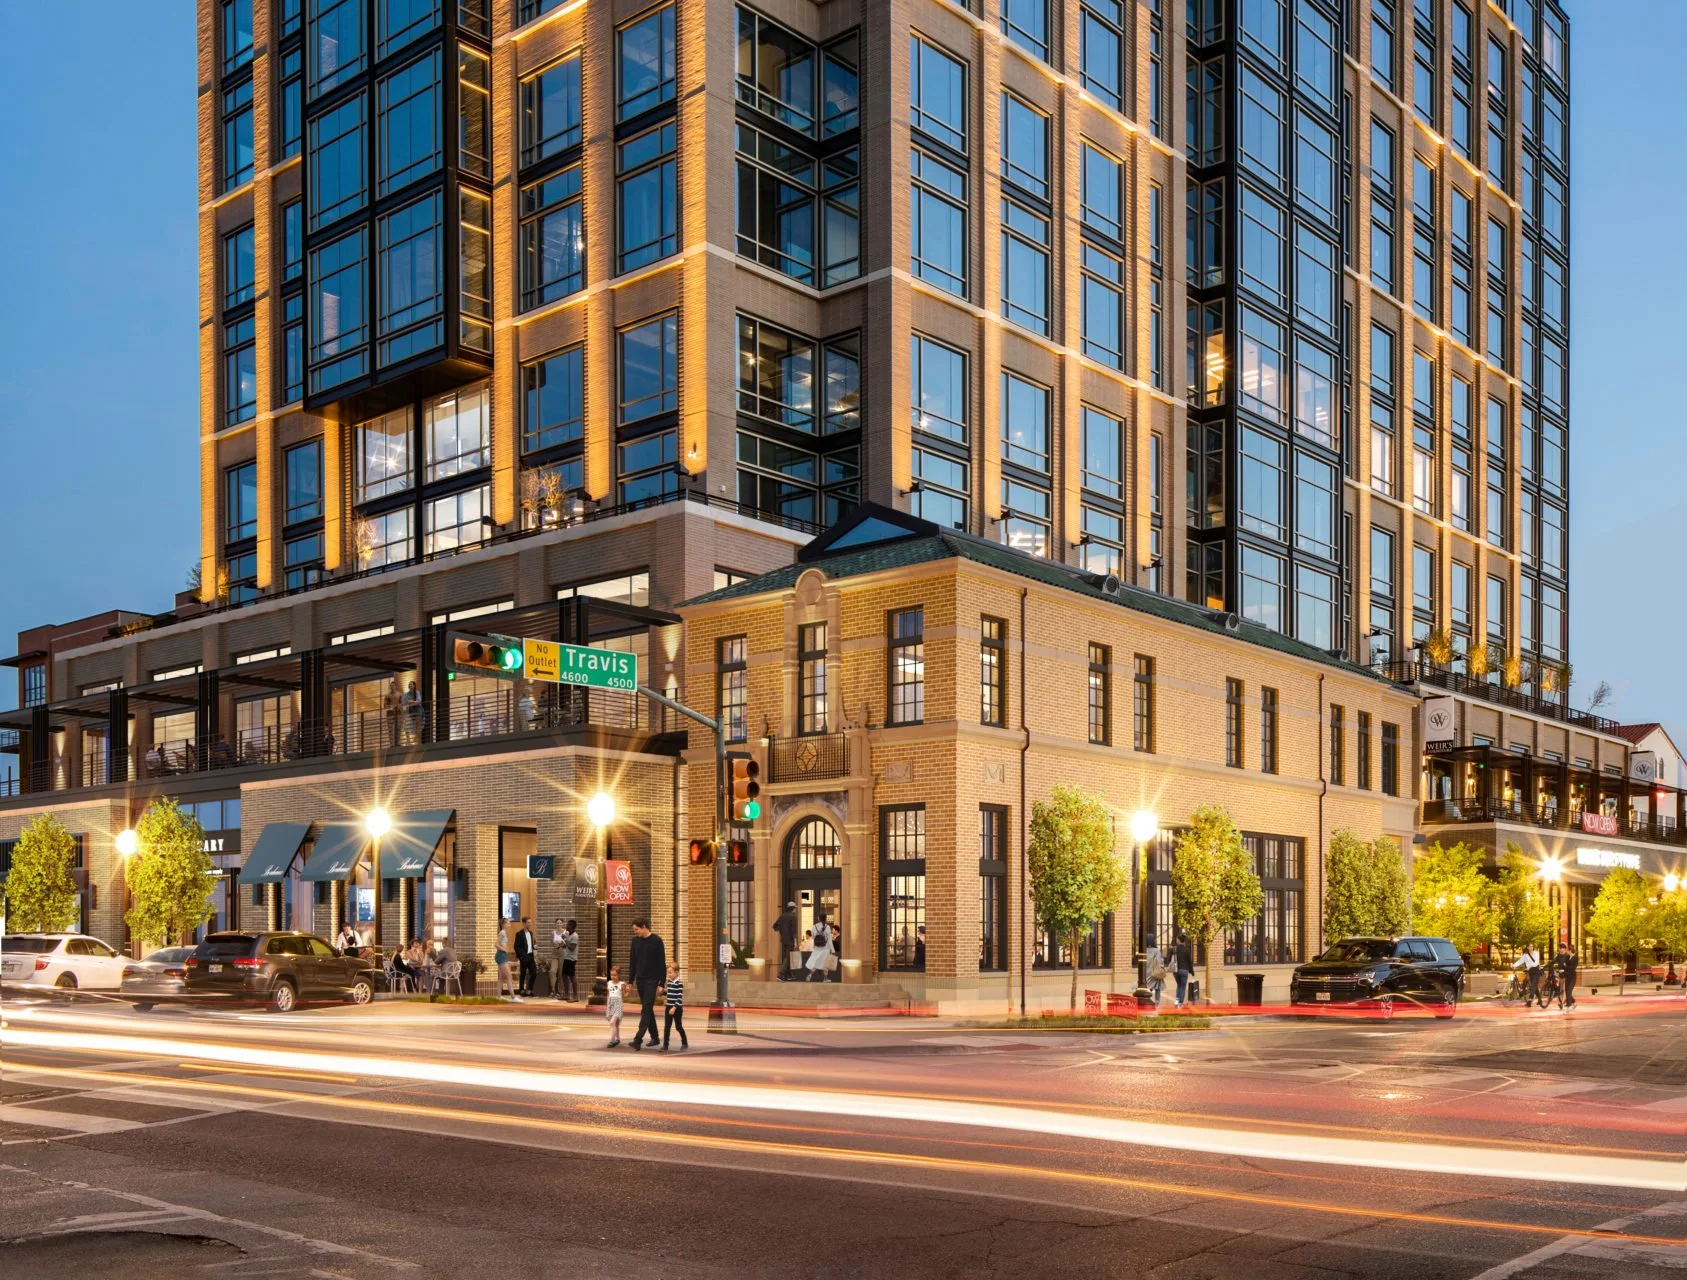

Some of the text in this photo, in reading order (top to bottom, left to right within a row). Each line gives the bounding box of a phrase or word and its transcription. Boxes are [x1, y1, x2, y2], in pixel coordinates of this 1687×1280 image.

[536, 644, 548, 654] No
[528, 655, 557, 668] Outlet
[565, 648, 629, 674] Travis
[561, 672, 633, 688] 4600 4500
[1427, 741, 1453, 750] WEIR'S
[576, 886, 597, 894] WEIR'S
[609, 885, 629, 893] NOW
[609, 892, 630, 900] OPEN
